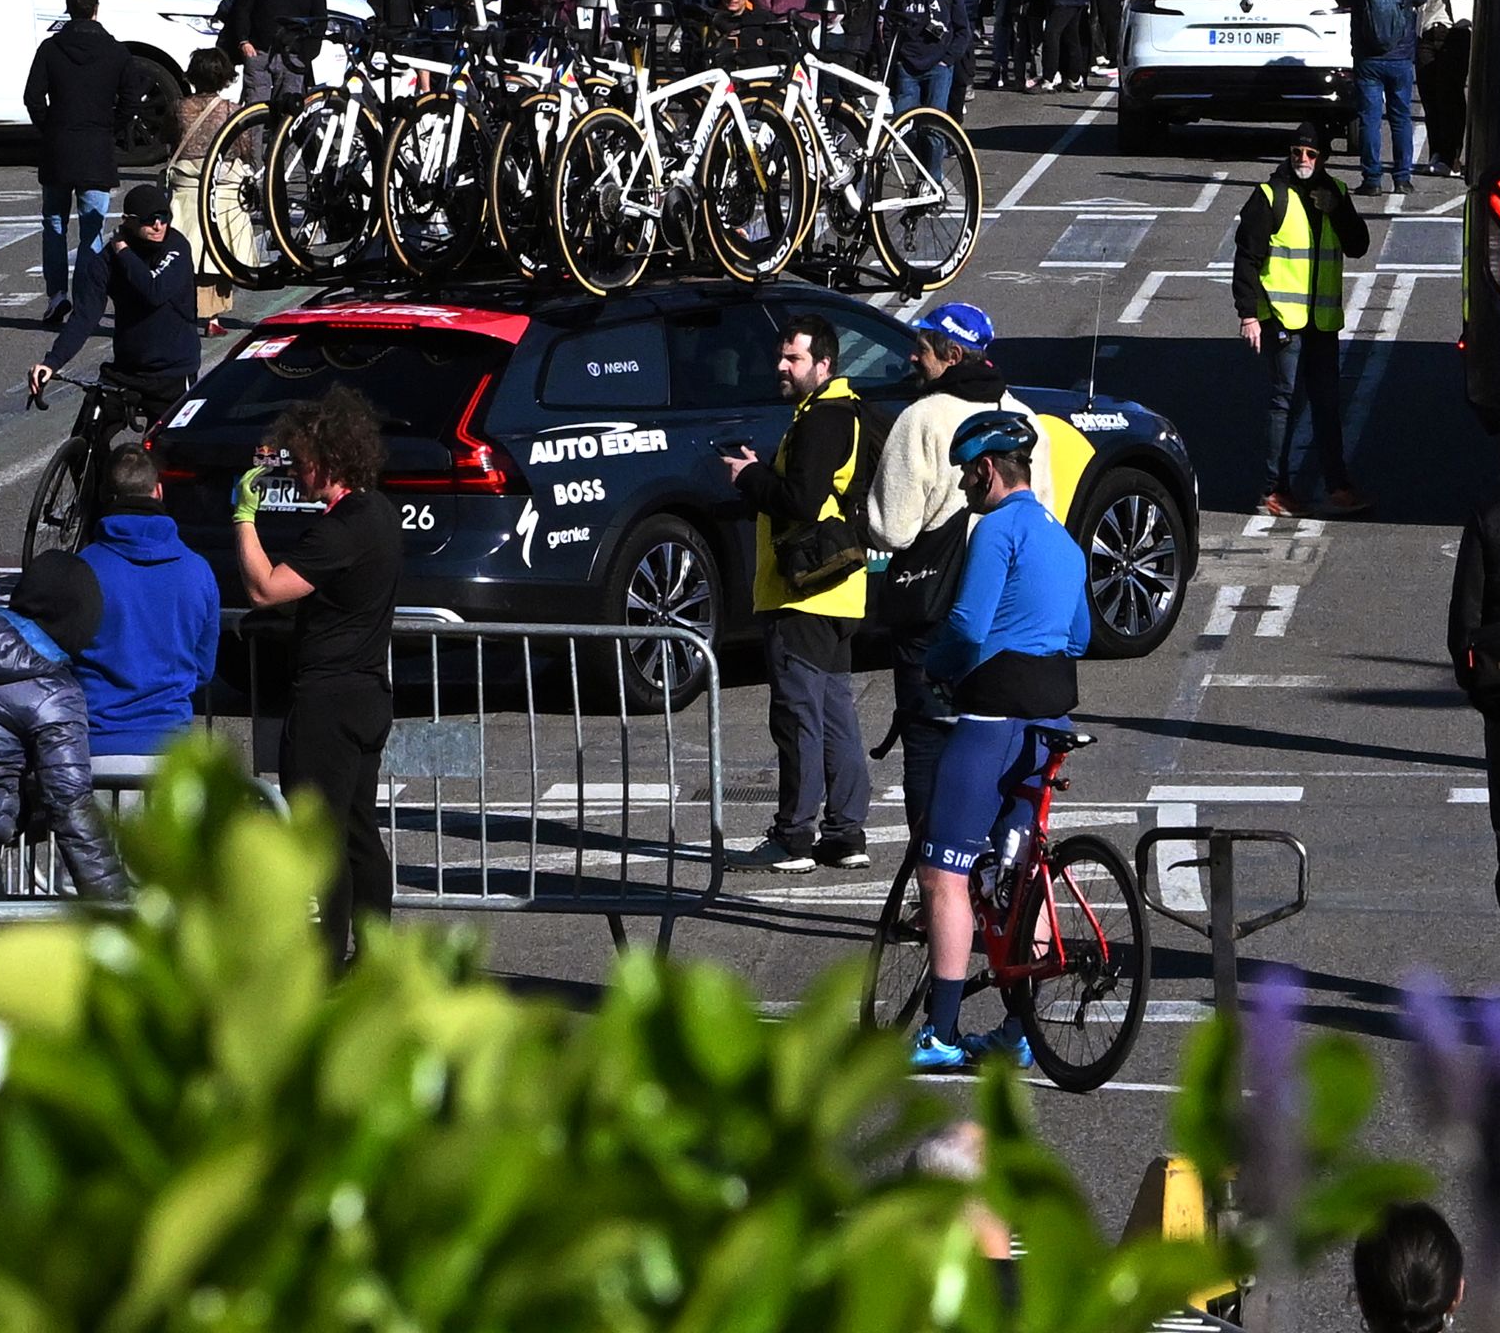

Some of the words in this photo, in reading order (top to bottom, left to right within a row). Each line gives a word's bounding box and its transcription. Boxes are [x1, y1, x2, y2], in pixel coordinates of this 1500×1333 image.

[1217, 32, 1252, 45] 2910
[1256, 32, 1282, 45] NBF
[528, 436, 599, 465] AUTO
[600, 429, 669, 457] EDER
[553, 478, 606, 506] BOSS
[401, 504, 435, 530] 26
[547, 526, 591, 550] grenke
